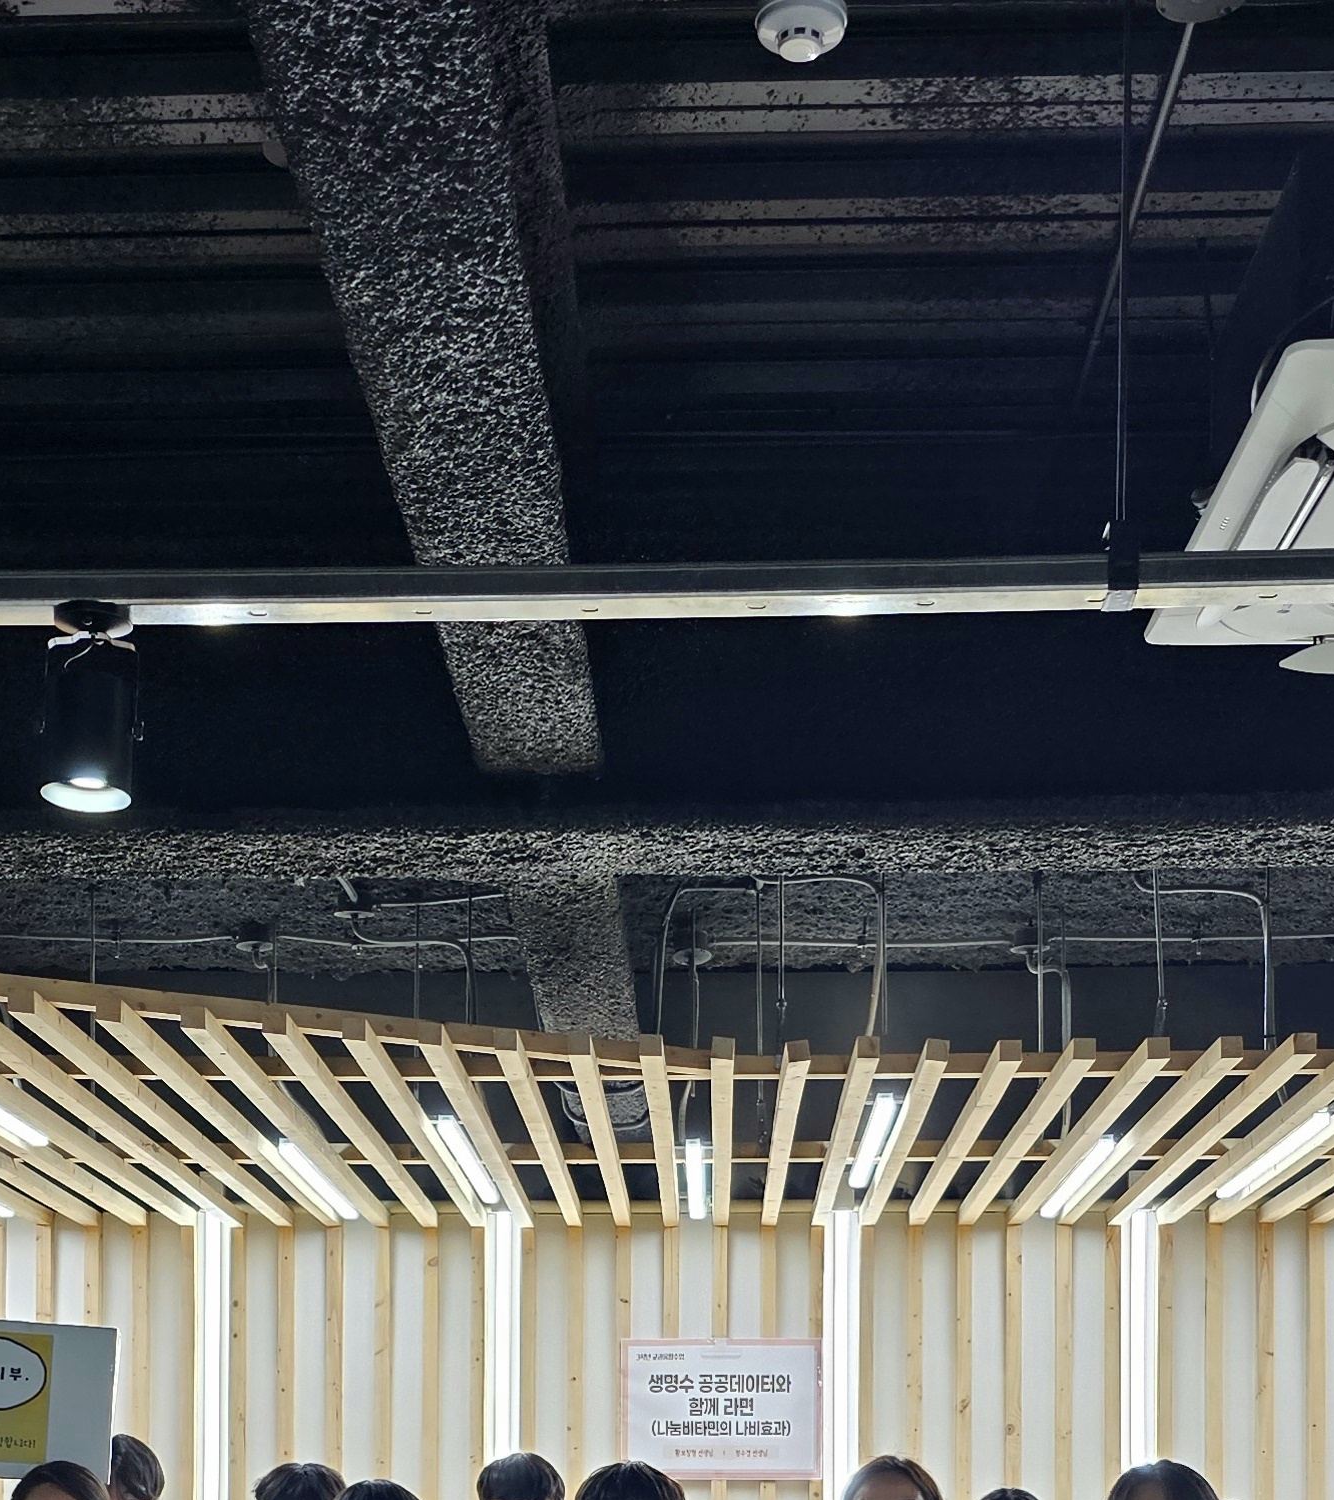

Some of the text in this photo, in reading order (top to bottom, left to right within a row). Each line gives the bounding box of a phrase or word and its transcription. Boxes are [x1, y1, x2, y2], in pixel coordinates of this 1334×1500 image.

[648, 1374, 791, 1393] 생명수 공공데이터와
[688, 1397, 754, 1416] 함께 라면
[652, 1420, 791, 1436] (나눔비타민의 나비효과)
